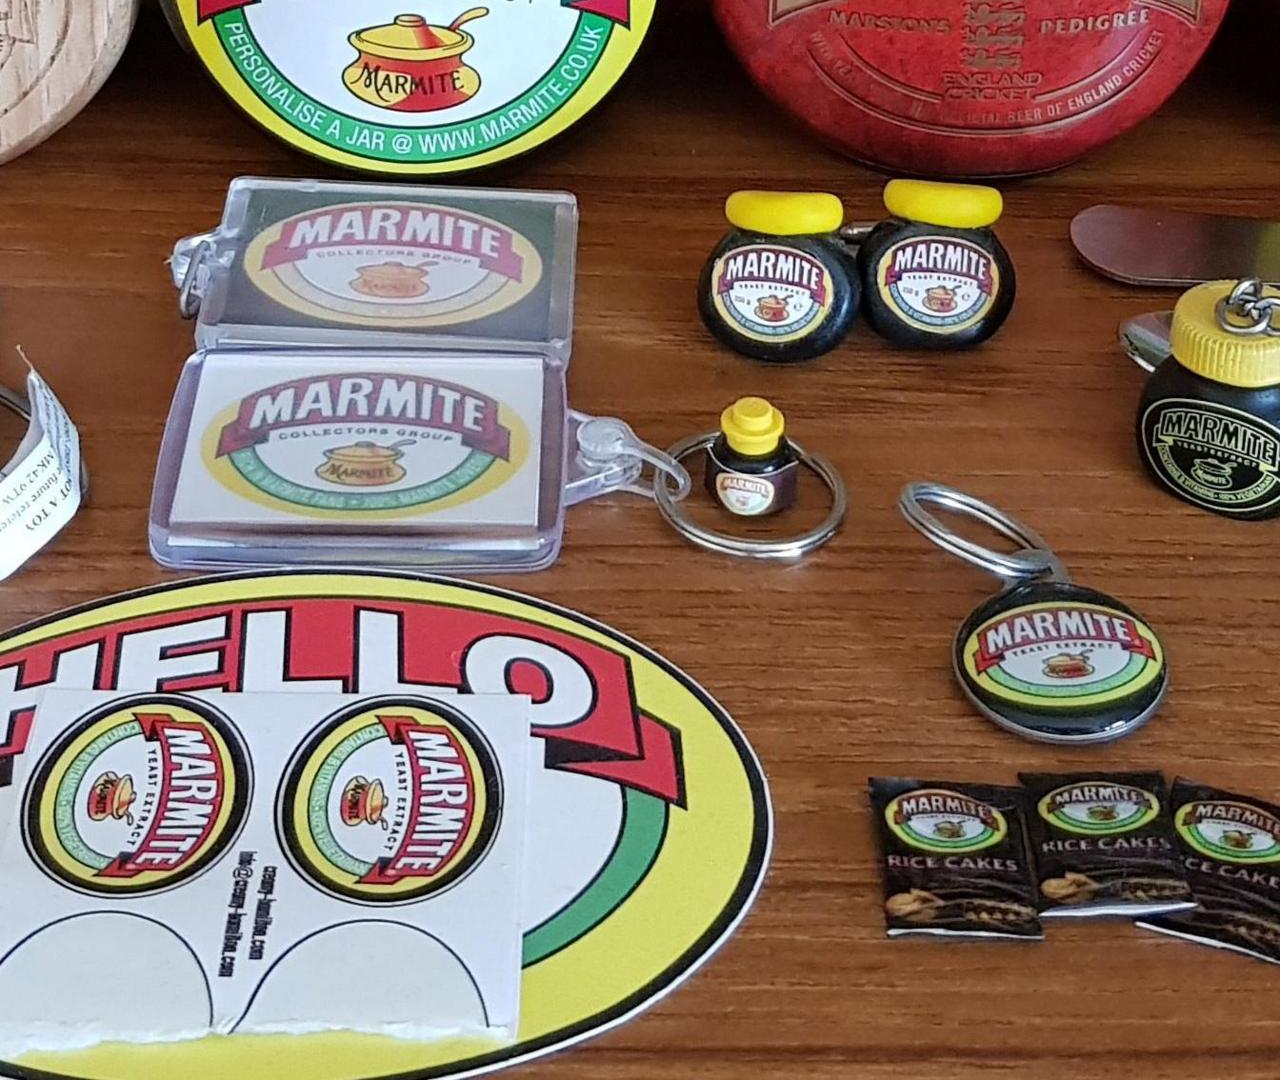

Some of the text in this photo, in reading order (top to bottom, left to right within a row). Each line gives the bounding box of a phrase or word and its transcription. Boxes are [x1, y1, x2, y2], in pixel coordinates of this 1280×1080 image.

[1039, 7, 1150, 35] PEDIGREE
[225, 21, 607, 155] PERSONALISE A JAR WWW.MARMITE.CO.UK
[350, 61, 466, 103] MARMITE
[943, 71, 1044, 87] ENGLAND
[943, 87, 1039, 102] CRICKET
[1046, 101, 1065, 119] OF
[1067, 75, 1123, 112] ENGLAND
[1122, 29, 1167, 79] CRICKET
[288, 208, 502, 259] MARMITE
[726, 250, 822, 291] MARMITE
[894, 241, 988, 281] MARMITE
[249, 377, 483, 432] MARMITE
[278, 426, 455, 442] COLLECTORS GROUP
[1162, 410, 1276, 469] MARMITE
[986, 609, 1131, 652] MARMITE
[125, 748, 158, 848] YEAST EXTRACT
[135, 726, 219, 870] MARMITE
[383, 751, 409, 852] YEAST EXTRACT
[395, 729, 472, 876] MARMITE
[902, 795, 992, 819] MARMITE
[1055, 786, 1142, 803] MARMITE
[888, 854, 1019, 871] RICE CAKES
[1041, 839, 1094, 852] RICE
